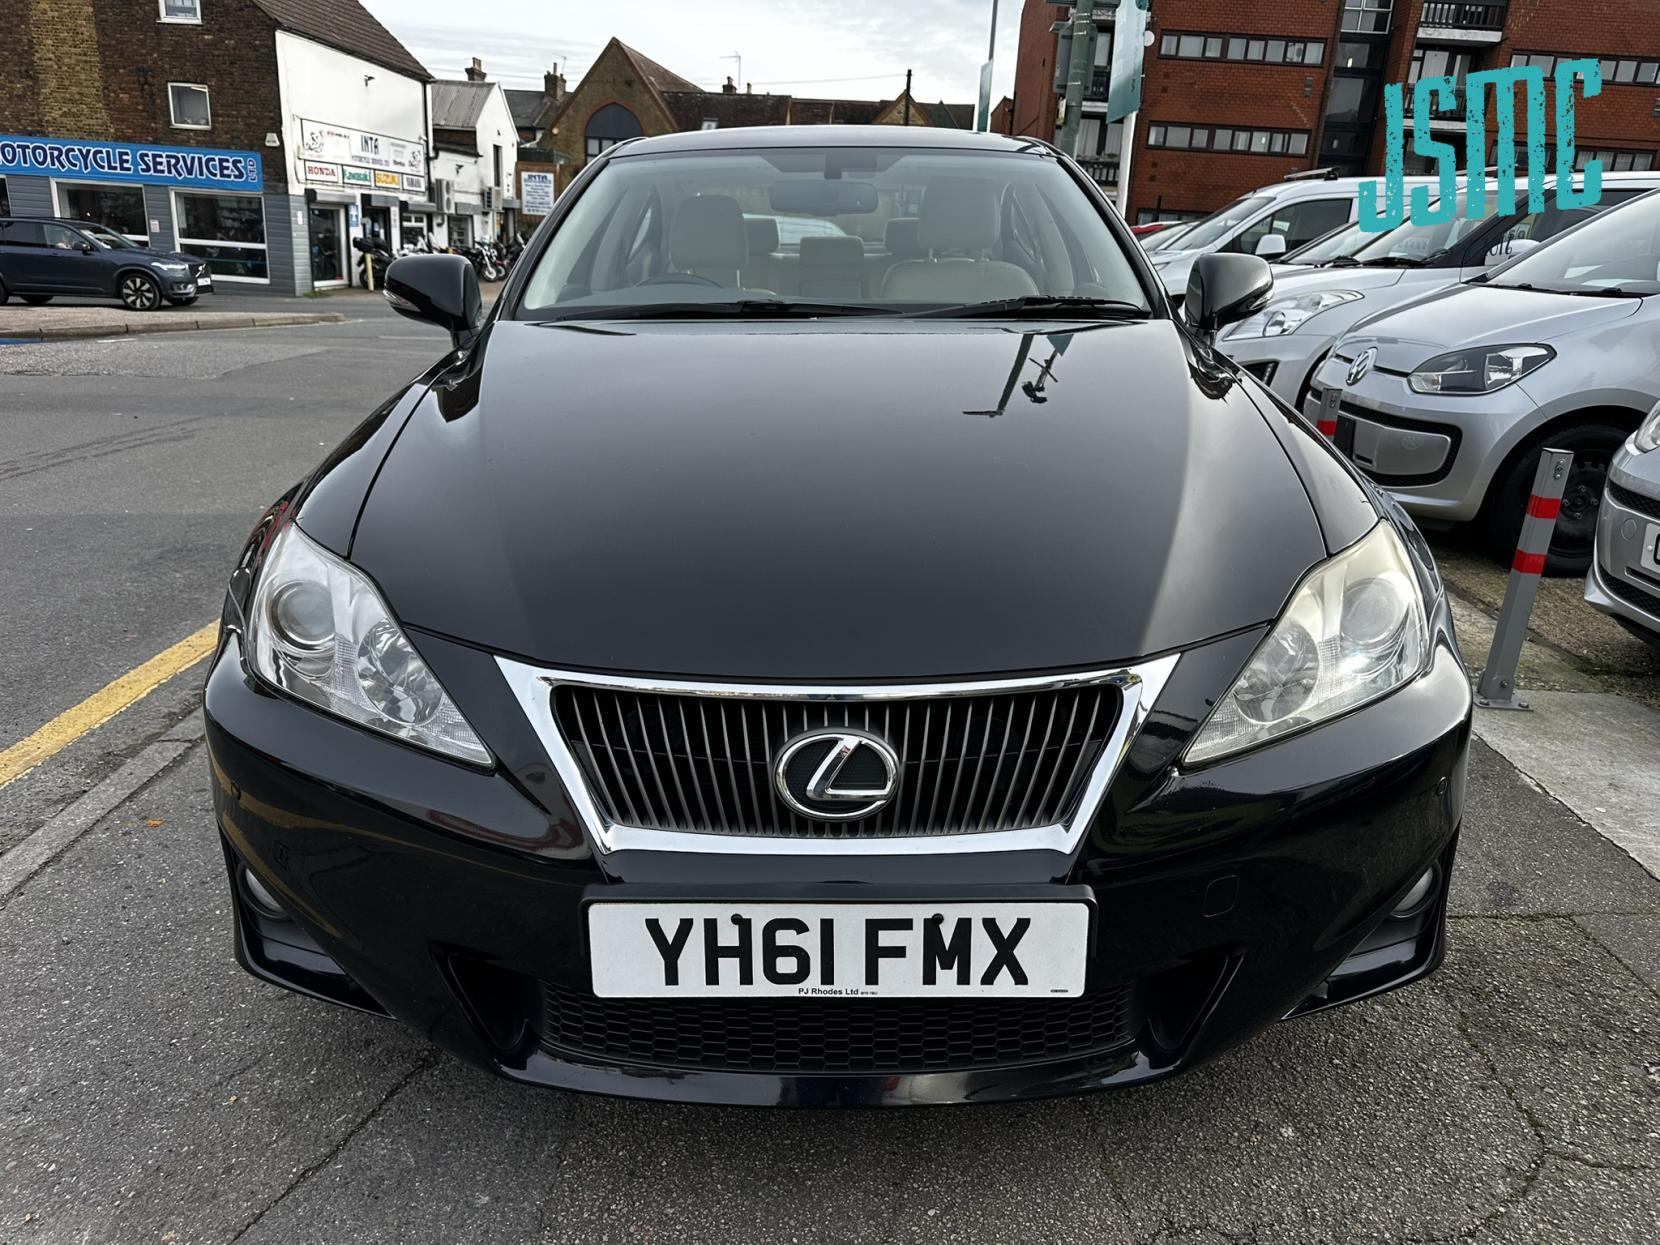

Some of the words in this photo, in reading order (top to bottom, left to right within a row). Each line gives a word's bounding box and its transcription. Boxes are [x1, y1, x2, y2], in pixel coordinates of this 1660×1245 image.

[361, 135, 379, 155] INTA
[0, 141, 132, 173] OTORCYCLE
[138, 151, 246, 181] SERVICES
[247, 157, 257, 182] LTD
[307, 165, 336, 177] HONDA
[376, 172, 399, 185] SUZUKI
[645, 917, 834, 986] YH61
[864, 917, 1031, 986] FMX
[811, 987, 843, 995] Rhodes
[845, 987, 859, 995] Ltd
